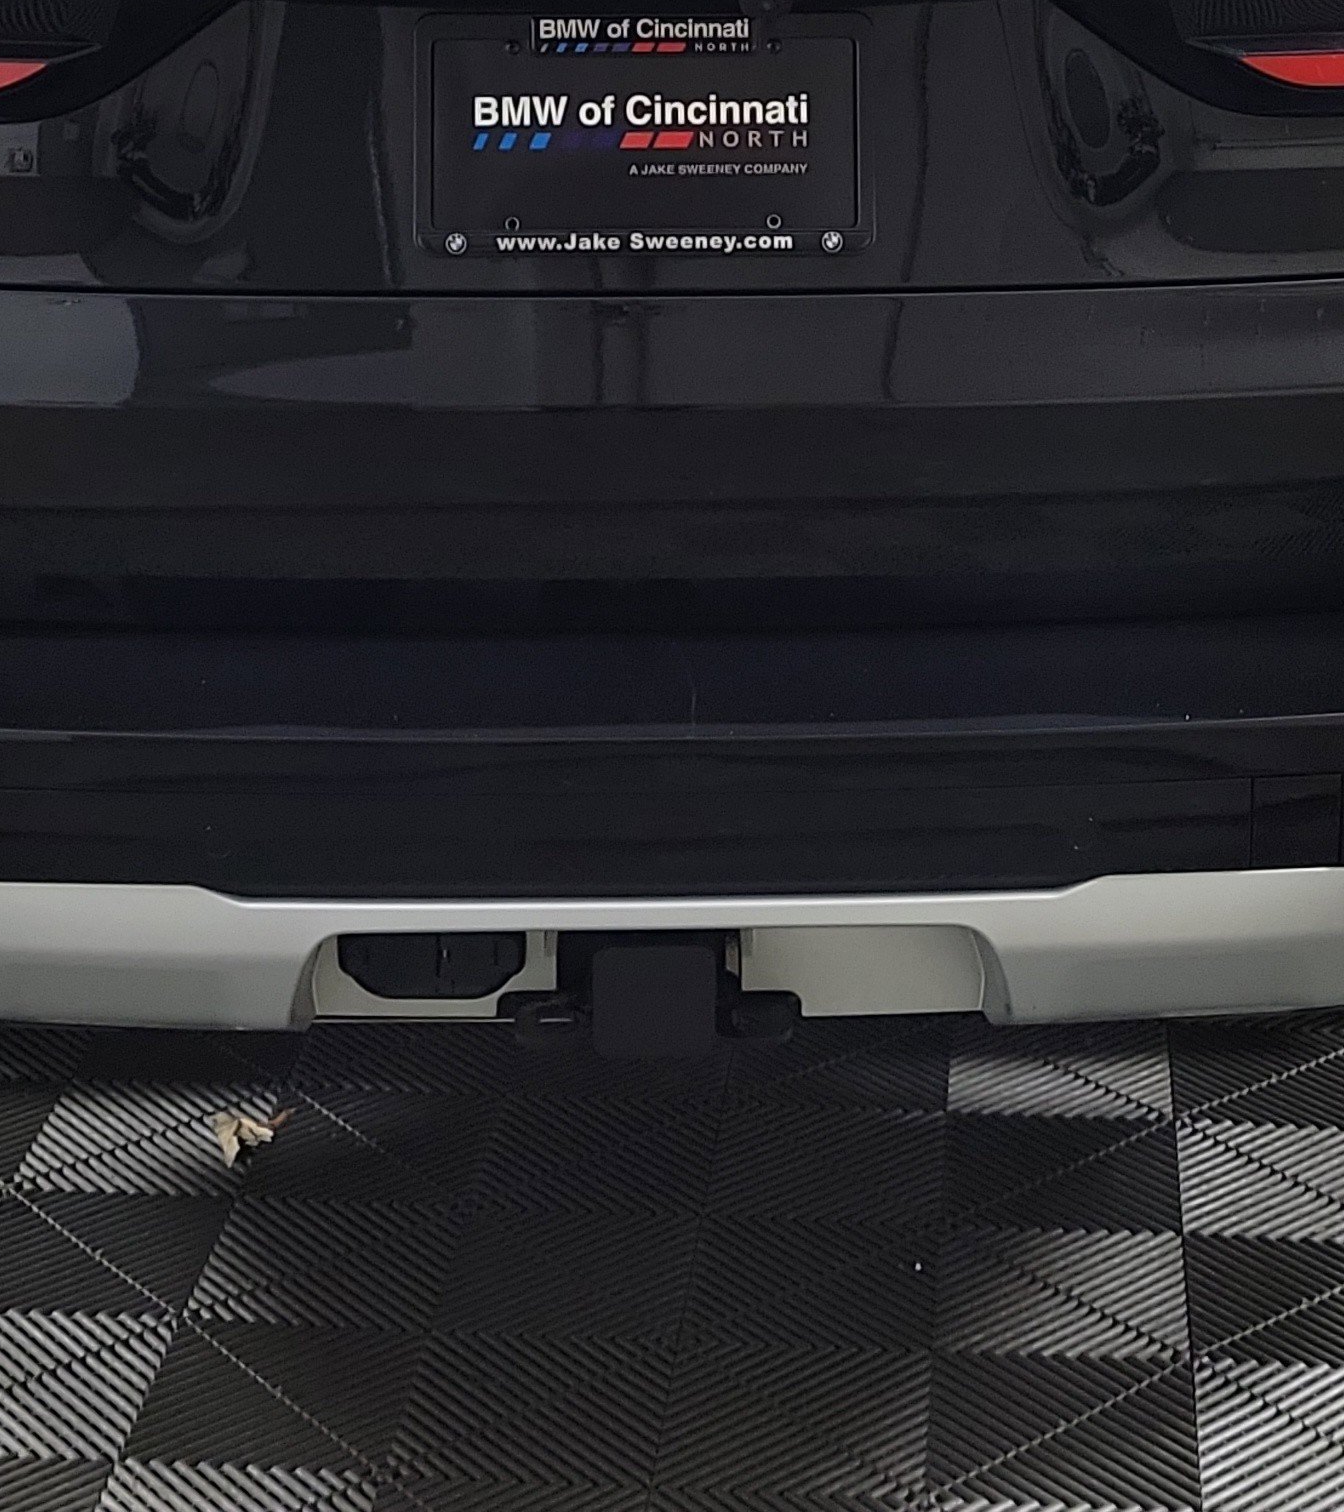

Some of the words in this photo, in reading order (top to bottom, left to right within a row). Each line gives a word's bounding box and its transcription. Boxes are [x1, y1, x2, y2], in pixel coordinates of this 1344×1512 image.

[539, 18, 601, 39] BMW
[606, 18, 630, 39] of
[635, 17, 749, 39] Cincinnati
[694, 42, 750, 53] NORTH
[473, 95, 569, 127] BMW
[578, 94, 615, 127] of
[625, 93, 809, 127] Cincinnati
[698, 129, 809, 149] NORTH
[629, 164, 639, 176] A
[641, 164, 675, 176] JAKE
[678, 163, 741, 175] SWEENEY
[743, 163, 809, 175] COMPANY
[495, 232, 621, 251] www.Jake
[629, 232, 794, 253] Sweeney.com
